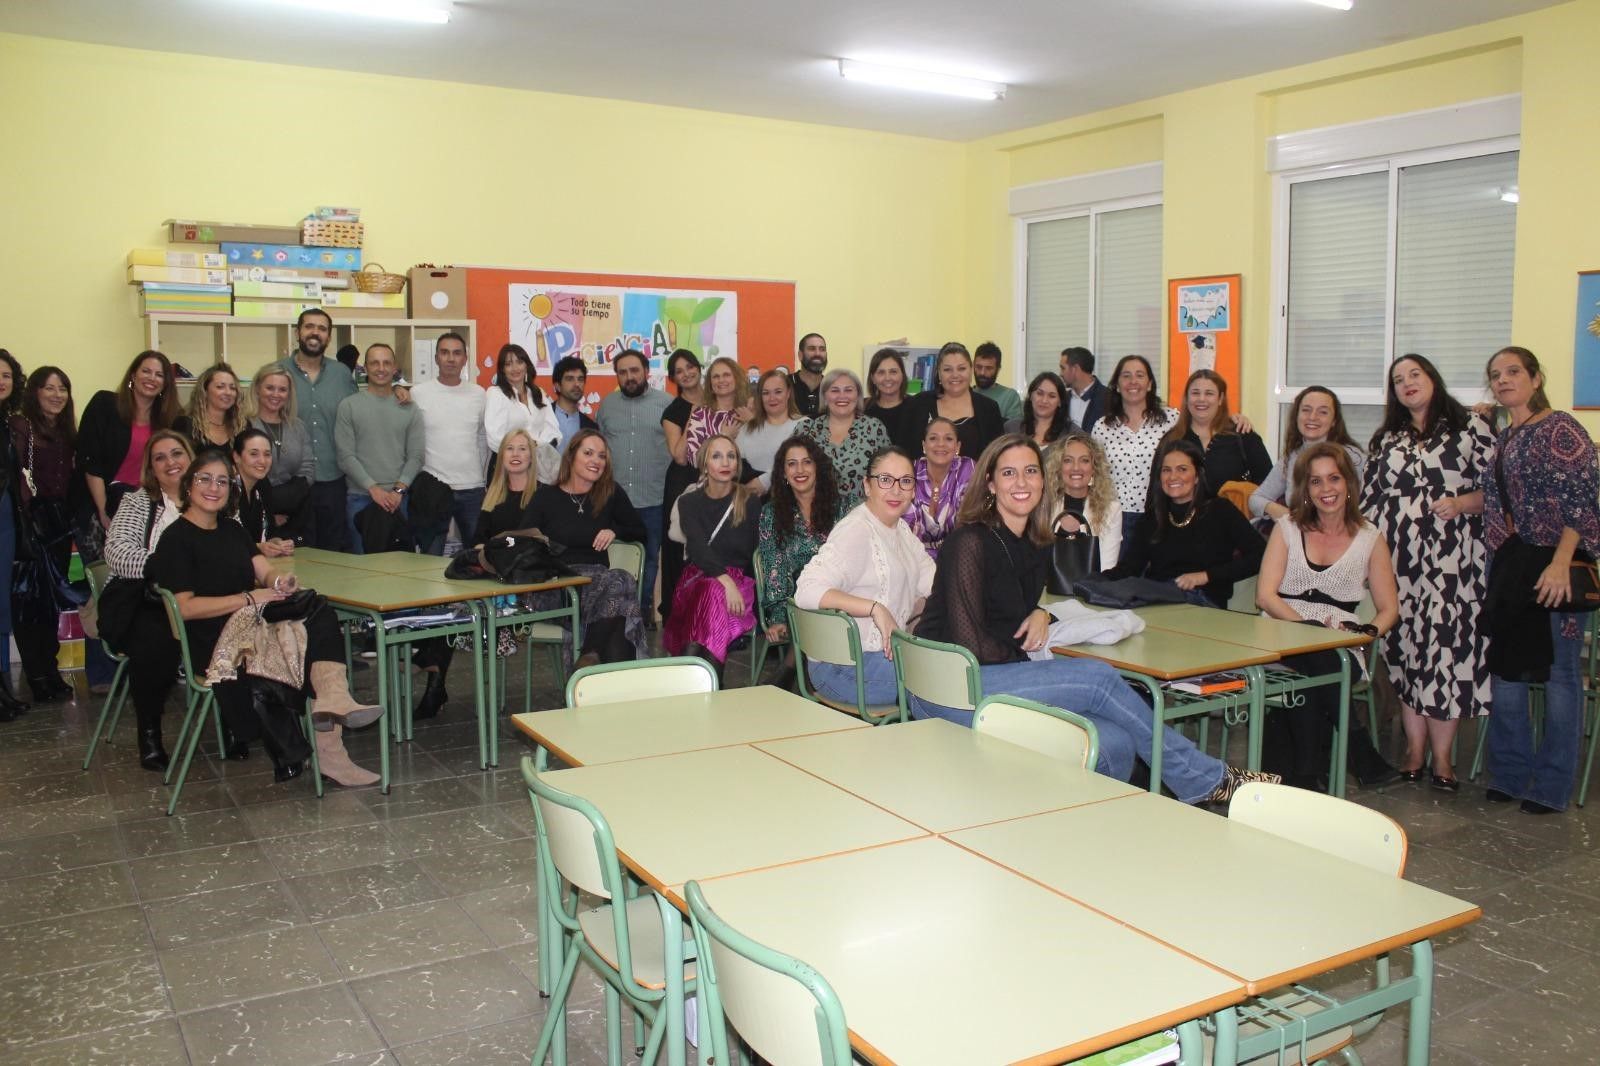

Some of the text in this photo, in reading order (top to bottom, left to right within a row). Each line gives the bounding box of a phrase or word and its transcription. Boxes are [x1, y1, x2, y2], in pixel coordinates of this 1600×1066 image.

[570, 297, 611, 310] Todo tiene
[571, 307, 609, 320] su tiempo
